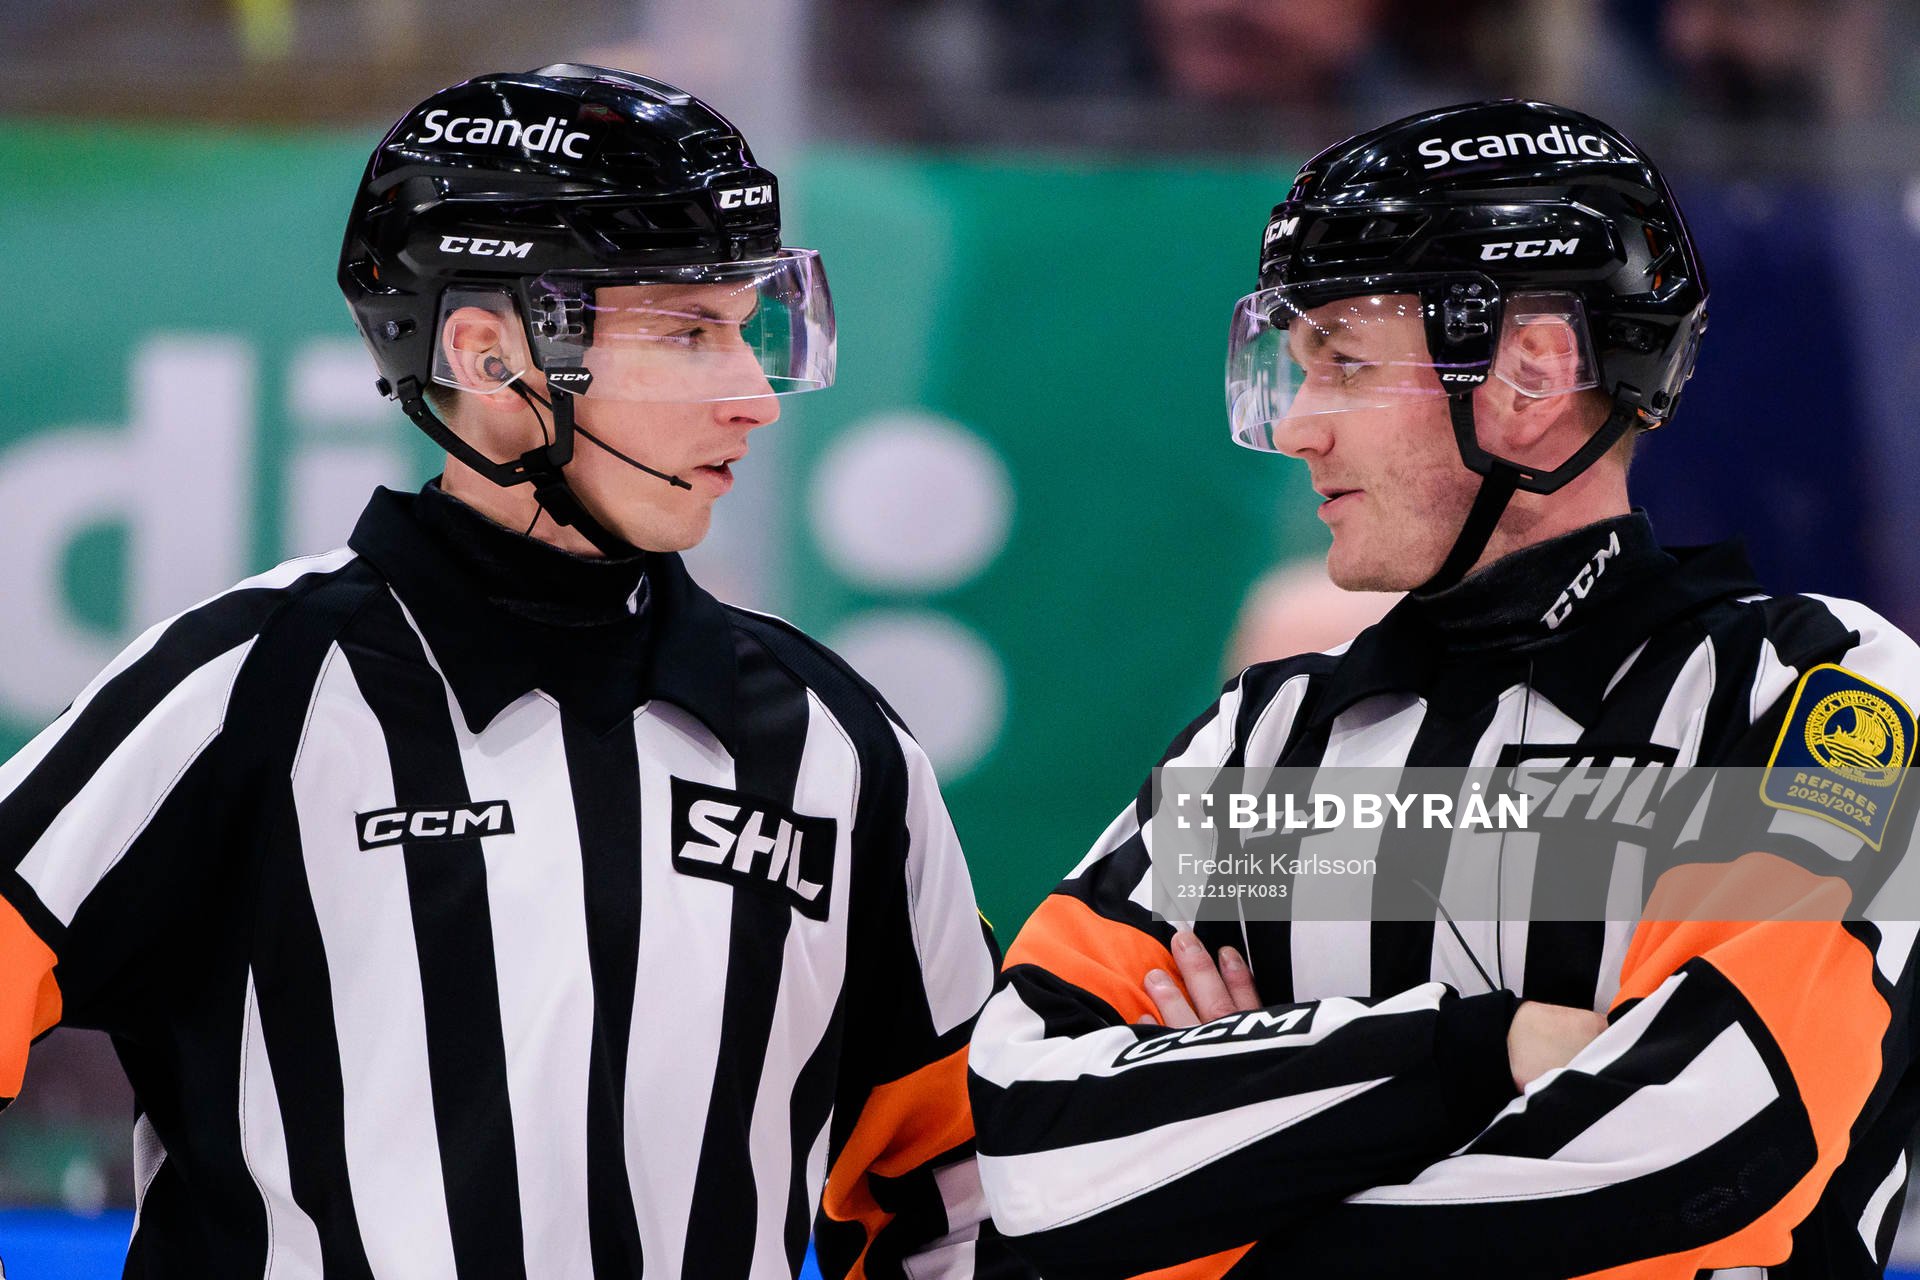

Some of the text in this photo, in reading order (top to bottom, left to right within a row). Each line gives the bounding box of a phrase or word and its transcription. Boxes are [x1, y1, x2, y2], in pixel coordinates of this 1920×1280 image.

[418, 109, 590, 160] Scandic
[1418, 125, 1605, 169] Scandic
[718, 184, 772, 209] CCM
[439, 235, 533, 259] CCM
[1264, 216, 1300, 249] CM
[1480, 238, 1580, 261] CCM
[549, 373, 590, 381] CCM
[1442, 373, 1485, 382] CCM
[1540, 531, 1621, 630] CCM
[1787, 785, 1872, 826] 2023/2024
[1794, 772, 1877, 815] REFEREE
[363, 805, 504, 843] CCM
[678, 800, 824, 901] SHL
[1123, 1006, 1312, 1062] CCM
